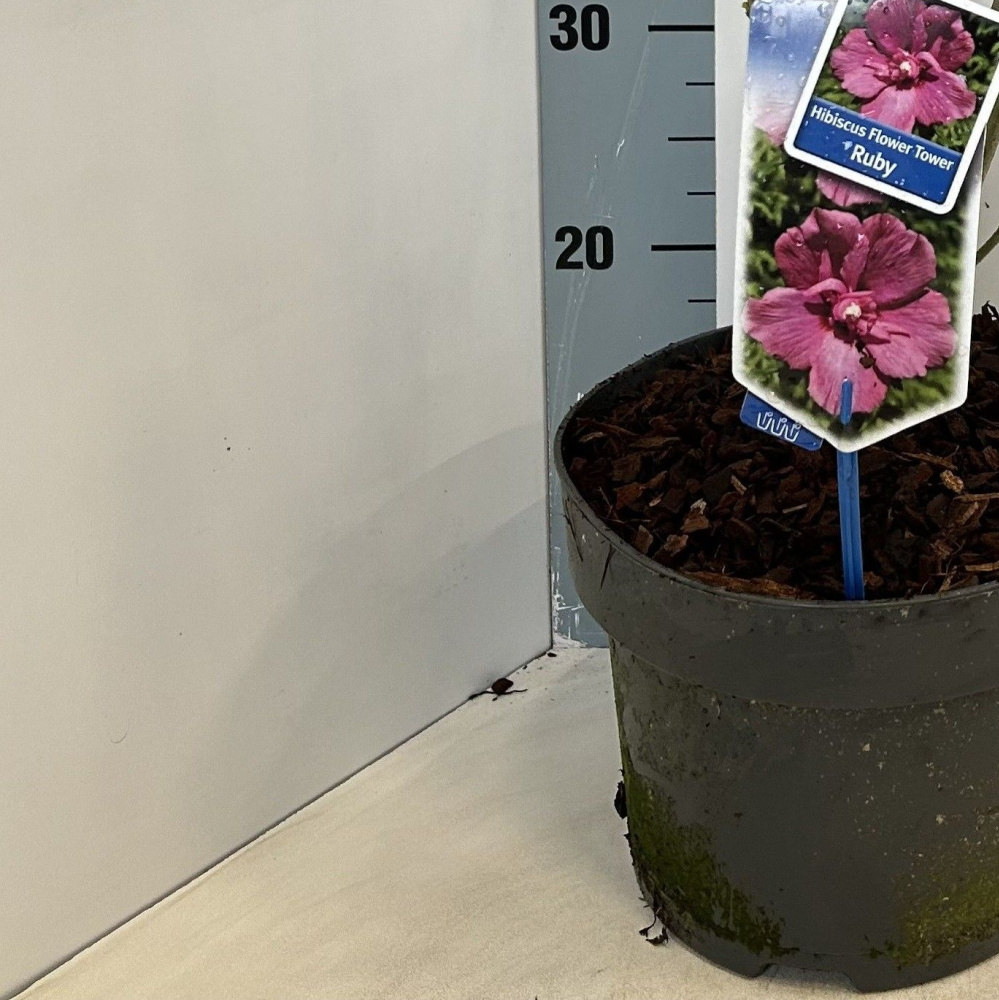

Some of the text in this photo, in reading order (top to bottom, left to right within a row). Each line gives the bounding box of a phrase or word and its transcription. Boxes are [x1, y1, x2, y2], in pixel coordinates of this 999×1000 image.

[549, 4, 611, 51] 30
[810, 104, 955, 171] Hibiscus Flower Tower
[850, 143, 898, 178] Ruby
[555, 226, 614, 270] 20
